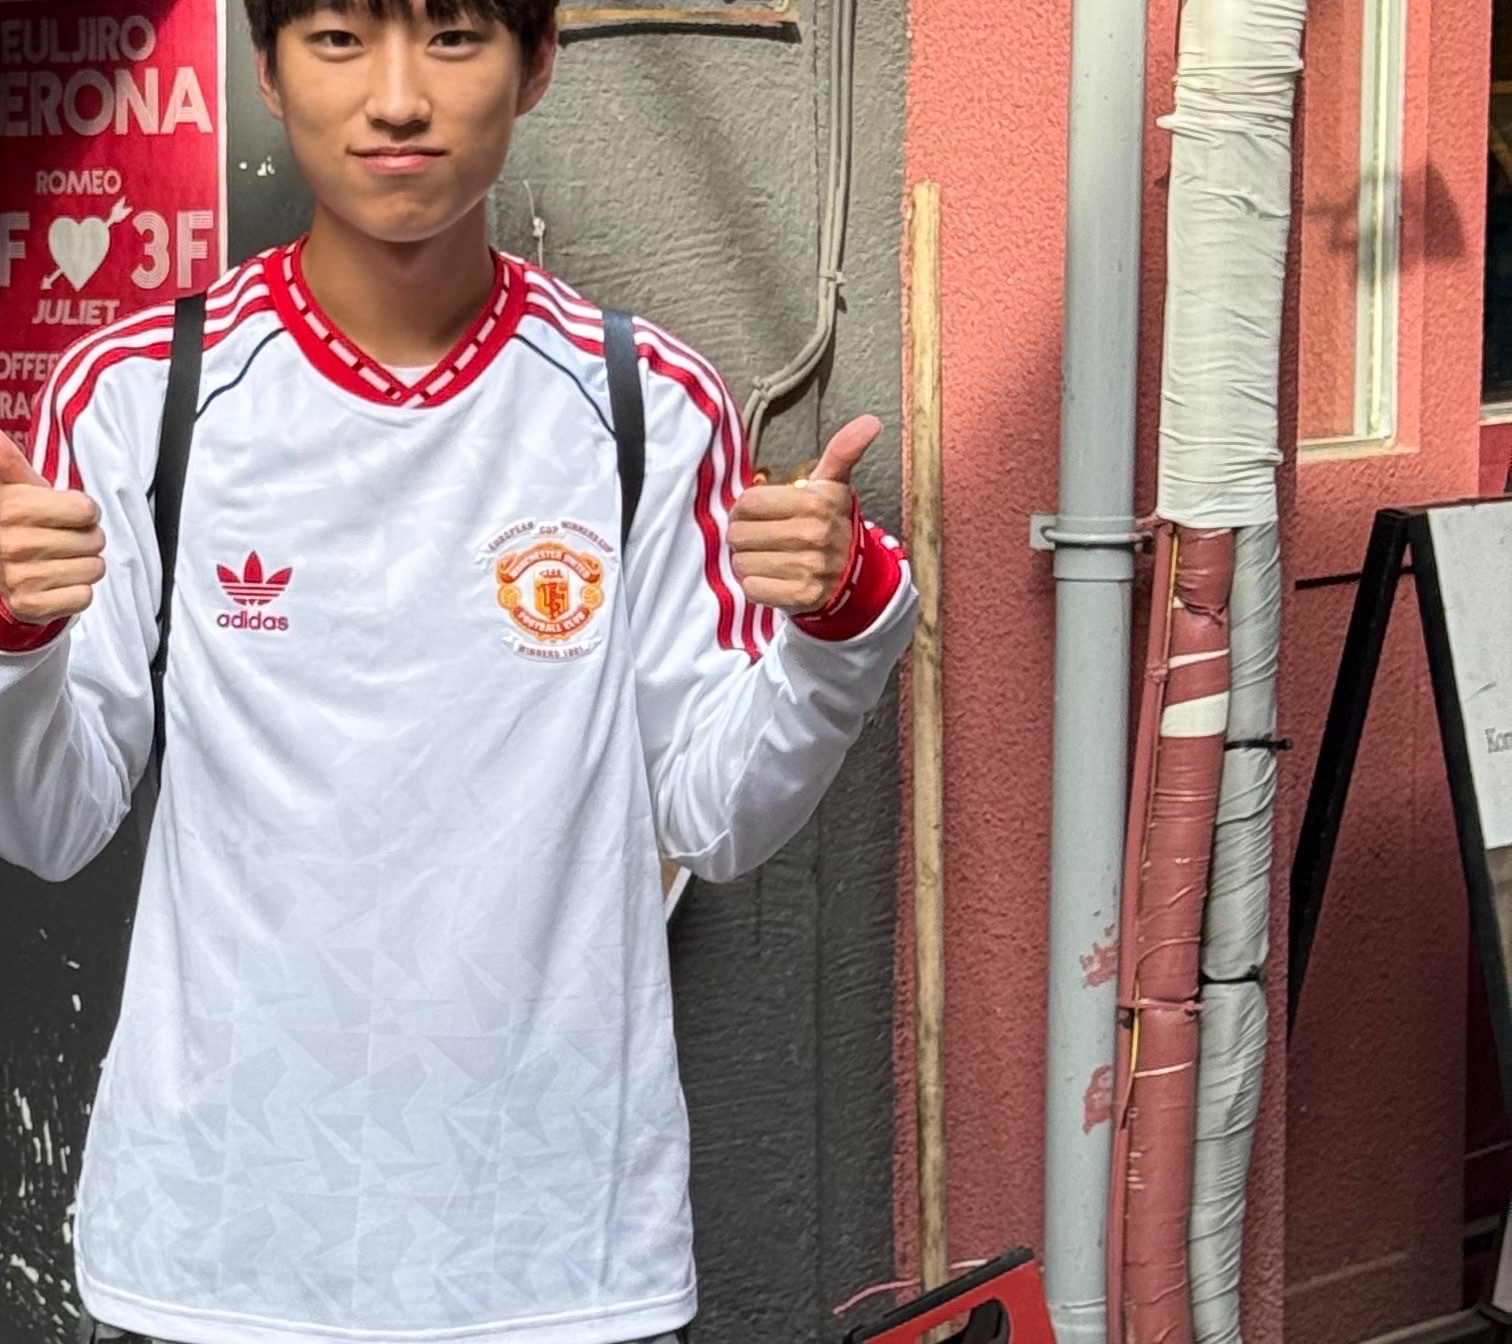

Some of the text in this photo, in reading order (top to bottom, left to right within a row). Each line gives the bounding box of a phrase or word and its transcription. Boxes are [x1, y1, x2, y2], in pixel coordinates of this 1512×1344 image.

[0, 14, 157, 65] EULJIRO
[35, 169, 122, 196] ROMEO
[131, 209, 215, 289] 3F
[31, 298, 121, 327] JULIET
[216, 610, 289, 632] adidas
